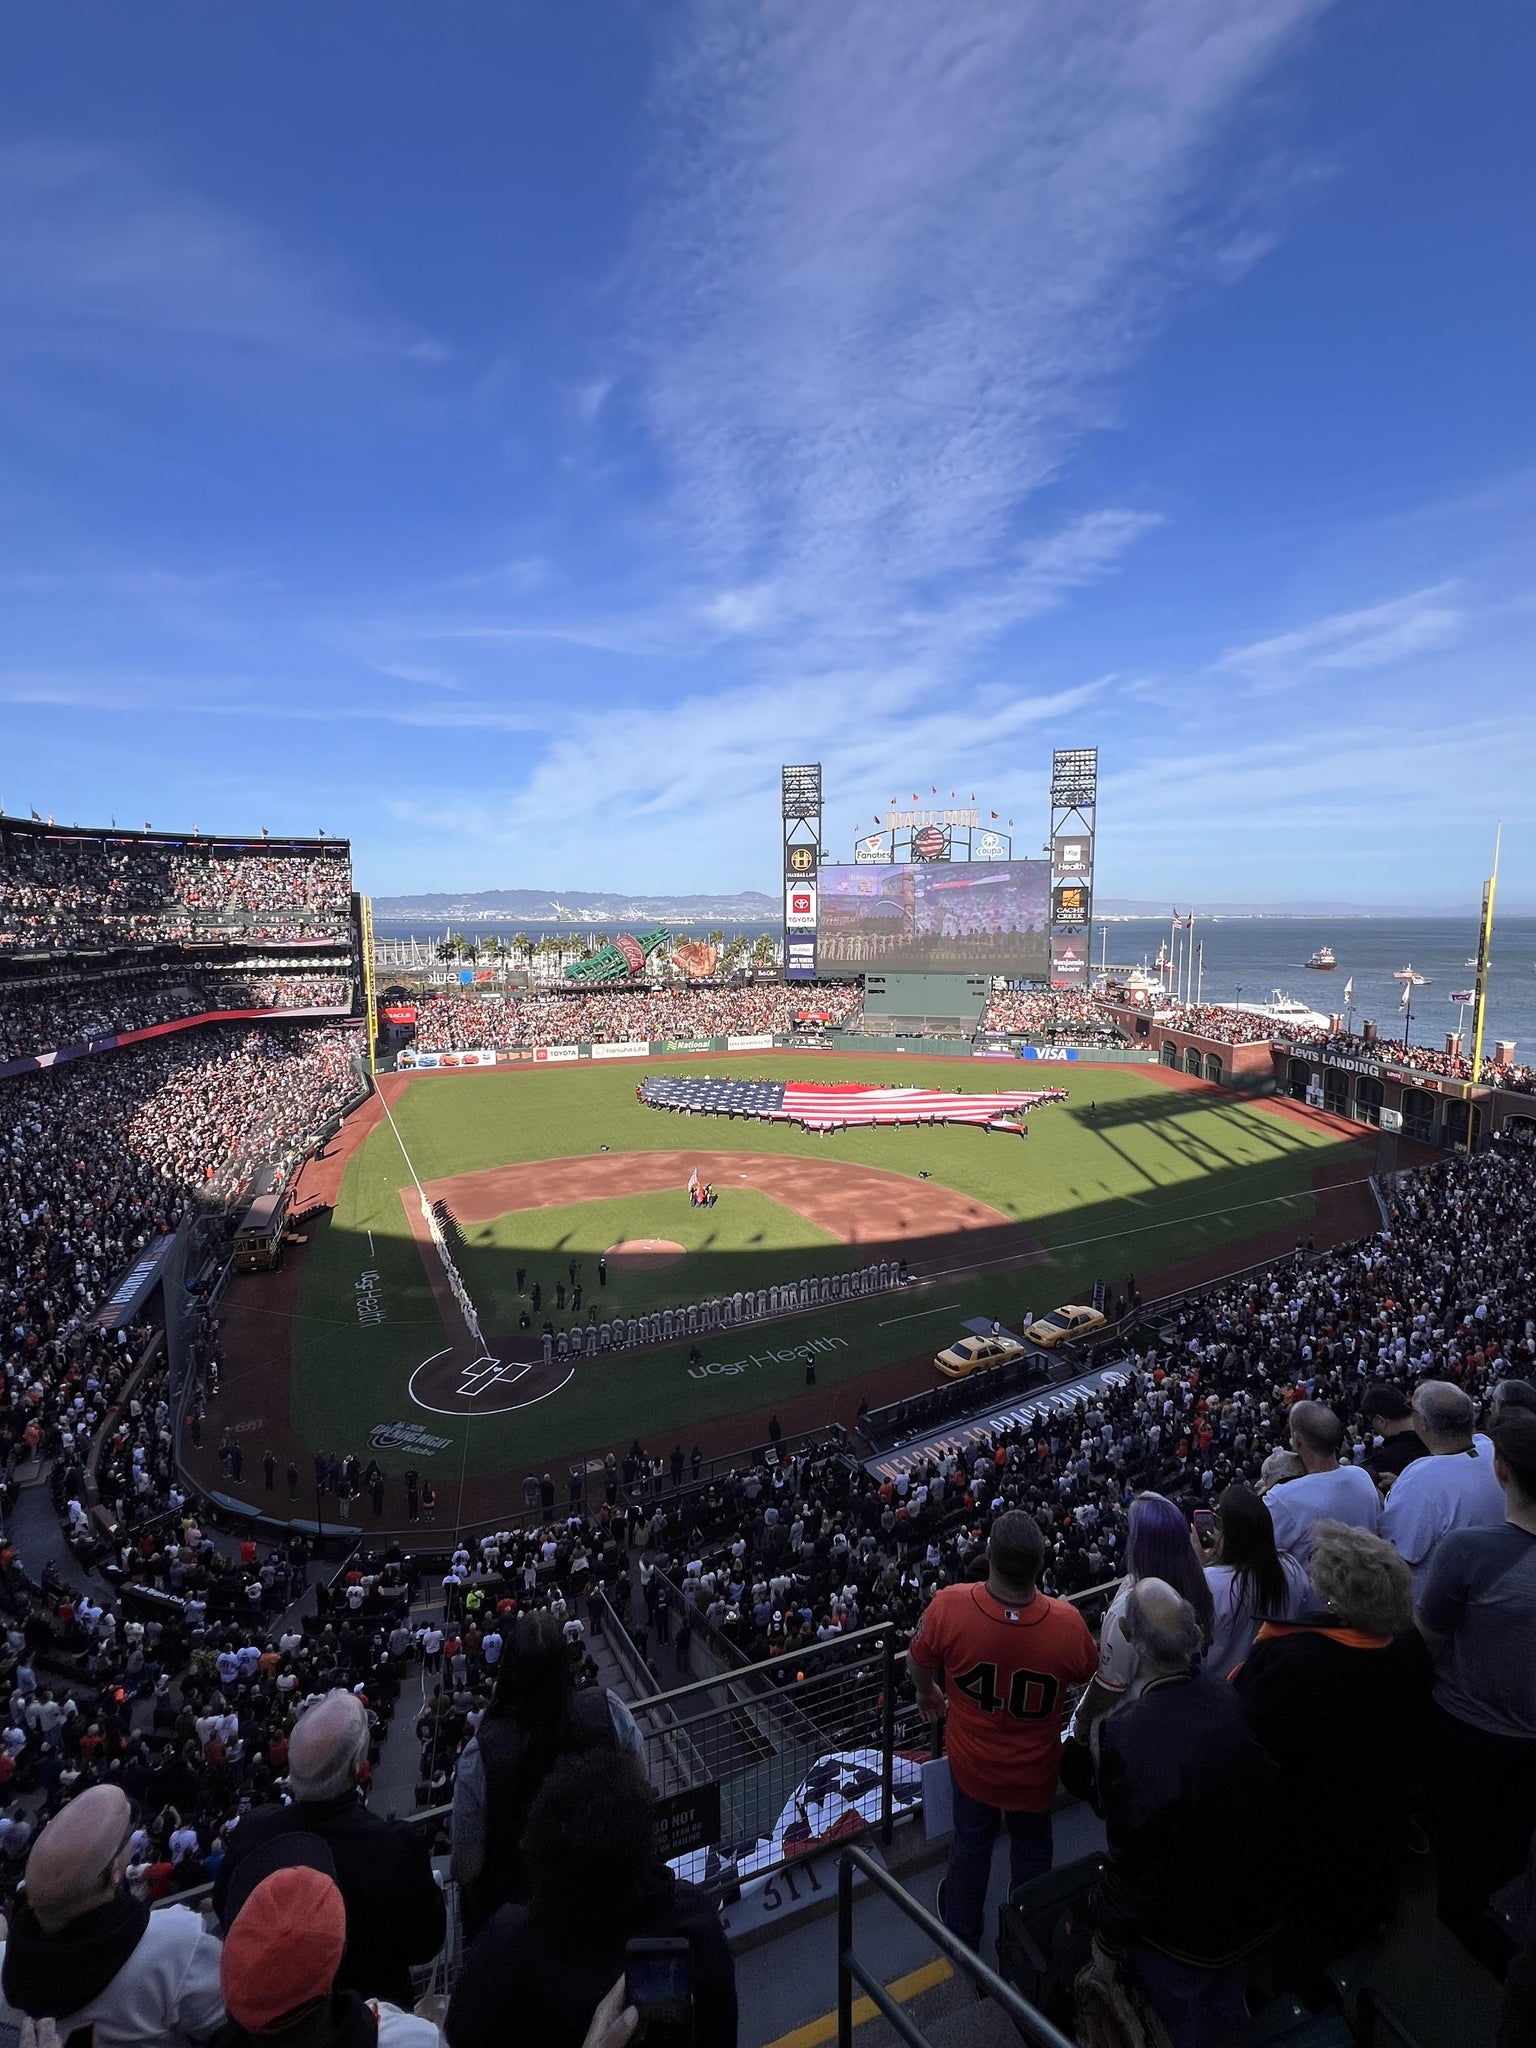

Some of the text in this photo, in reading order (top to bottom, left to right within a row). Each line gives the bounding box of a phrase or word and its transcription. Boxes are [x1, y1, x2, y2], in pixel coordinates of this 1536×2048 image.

[943, 809, 979, 828] PARK
[856, 851, 892, 860] Fanatics
[1058, 863, 1086, 871] Health
[1053, 958, 1085, 967] Benjamin
[677, 1040, 711, 1049] National
[550, 1049, 577, 1057] TOYOTA
[1035, 1047, 1068, 1060] VISA
[1322, 1053, 1380, 1077] LANDING
[687, 1336, 849, 1378] UCSF Health
[952, 1661, 1059, 1720] 40
[671, 1808, 696, 1828] NOT
